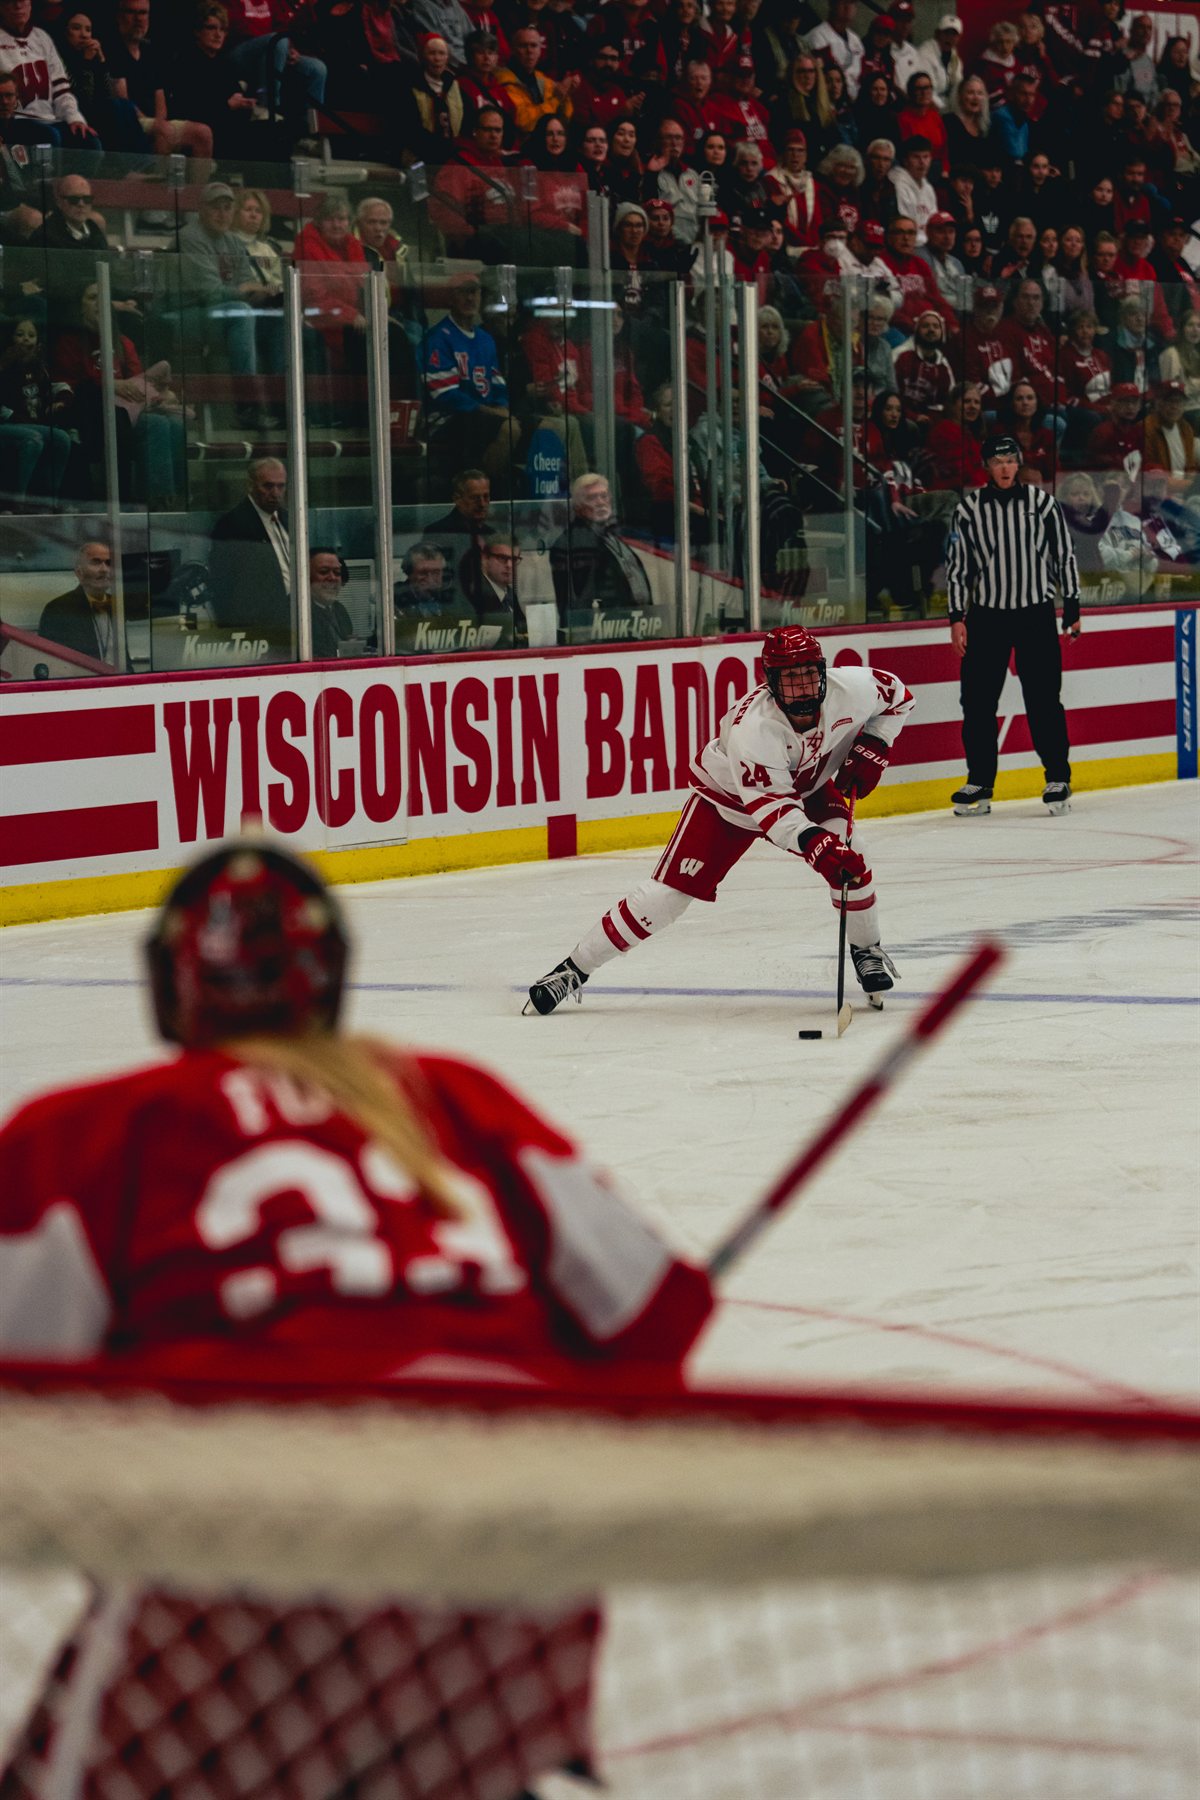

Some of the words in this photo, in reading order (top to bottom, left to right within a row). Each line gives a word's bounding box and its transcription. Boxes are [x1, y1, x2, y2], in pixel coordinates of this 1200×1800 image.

[533, 452, 561, 472] Cheer
[413, 621, 455, 650] KWIK
[591, 612, 632, 640] KWIK
[631, 609, 663, 640] TRIP
[1180, 637, 1193, 752] BAUER
[163, 673, 561, 843] WISCONSIN
[740, 760, 773, 788] 24
[806, 834, 834, 866] UER
[678, 857, 705, 878] W
